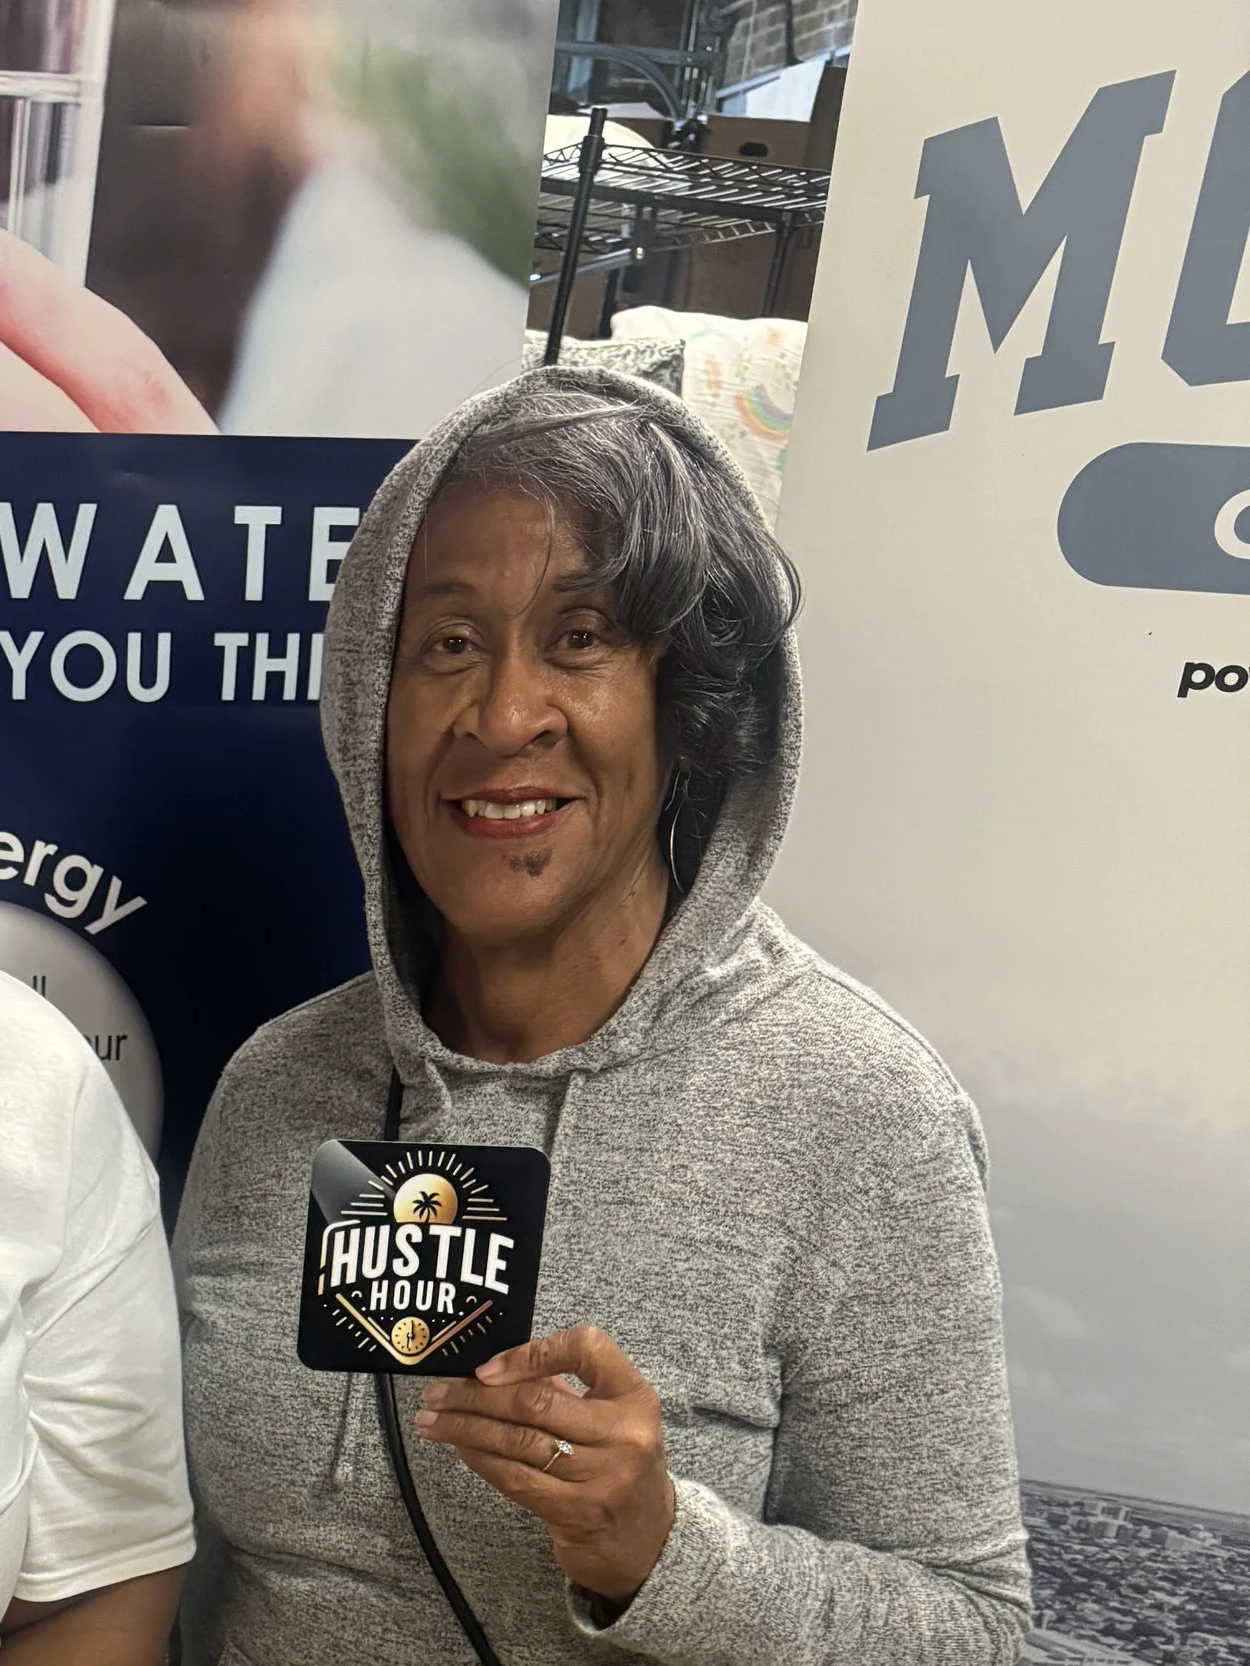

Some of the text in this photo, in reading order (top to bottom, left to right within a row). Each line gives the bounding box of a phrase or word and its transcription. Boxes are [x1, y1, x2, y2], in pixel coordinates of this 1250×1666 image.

[213, 632, 325, 701] THI
[1176, 661, 1250, 699] po
[329, 1223, 515, 1296] HUSTLE
[369, 1278, 457, 1315] HOUR
